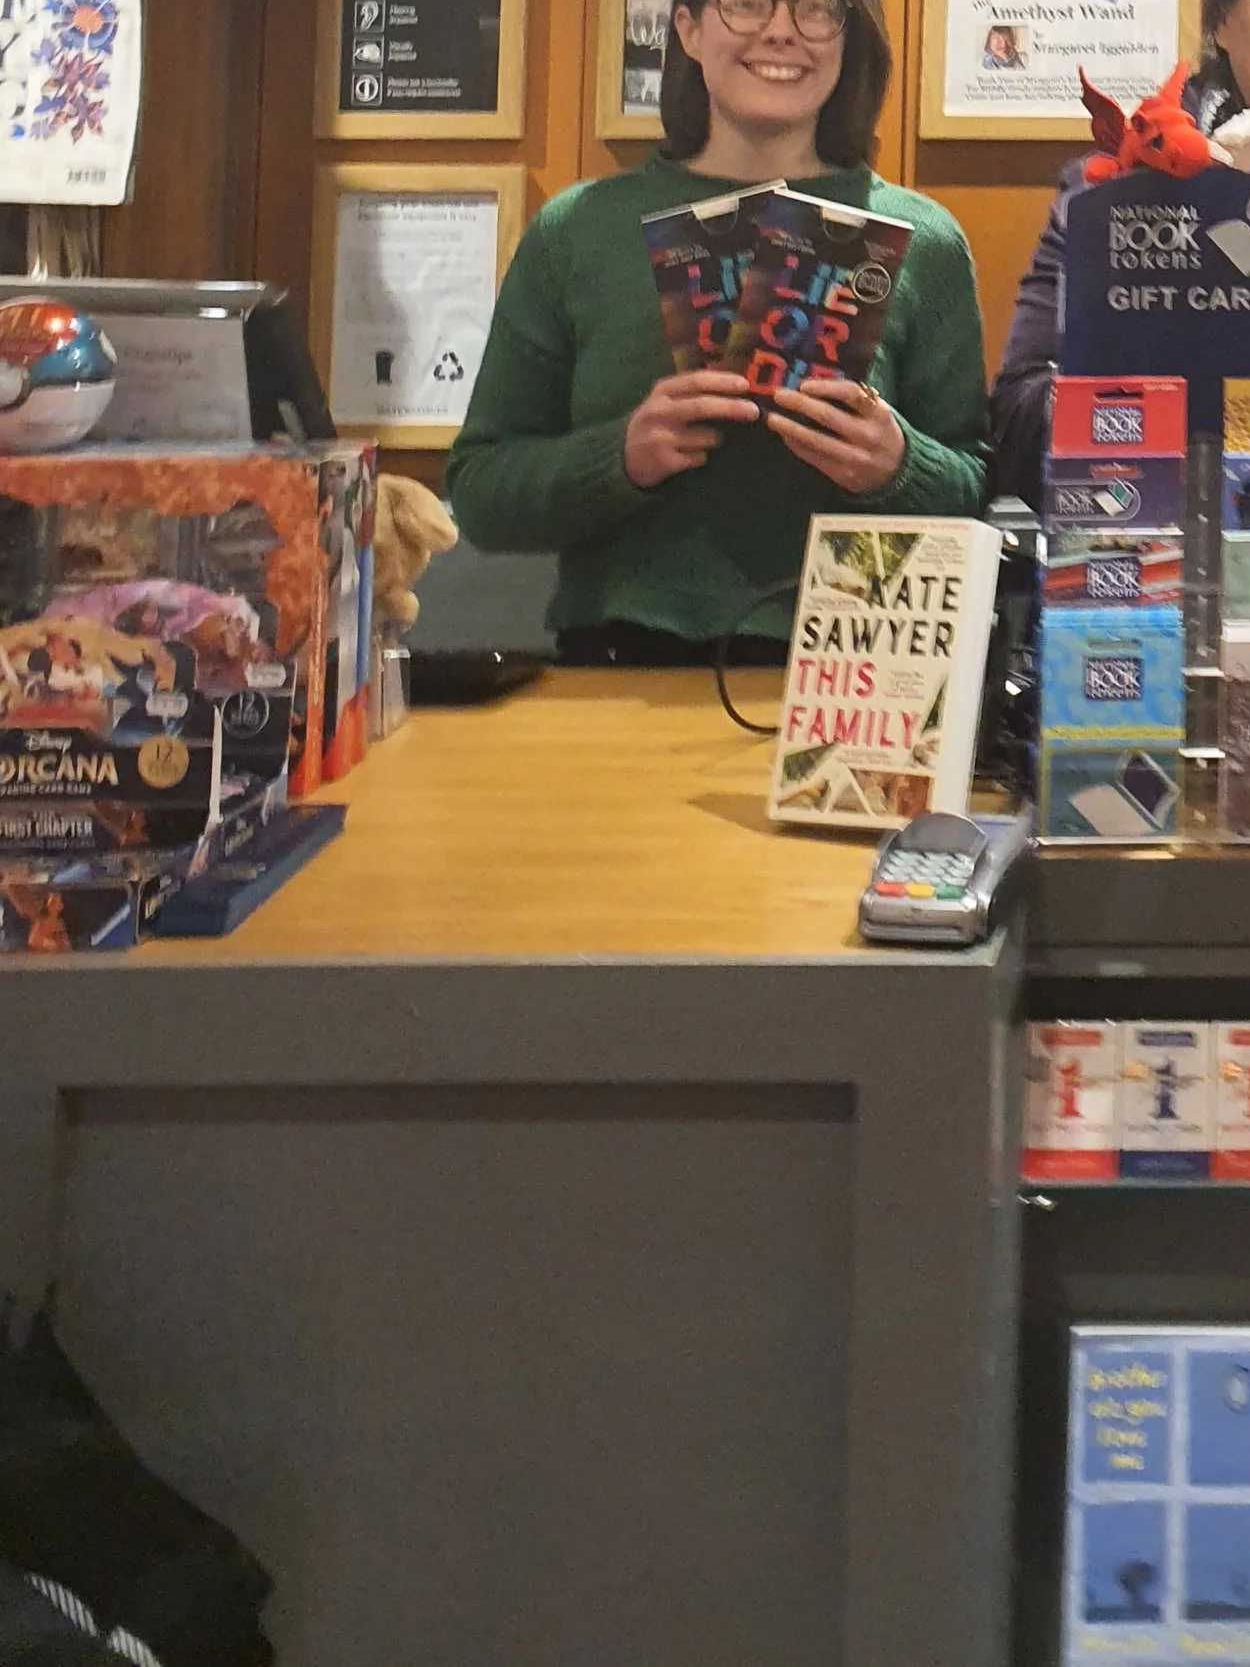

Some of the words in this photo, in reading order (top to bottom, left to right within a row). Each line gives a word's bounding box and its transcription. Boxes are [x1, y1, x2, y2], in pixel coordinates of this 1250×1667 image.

[987, 2, 1074, 22] Amethyst
[1080, 3, 1136, 21] Wand
[1109, 203, 1202, 222] NATIONAL
[1108, 220, 1202, 252] BOOK
[1109, 249, 1203, 270] tokens
[773, 254, 860, 316] LIE
[1107, 285, 1179, 312] GIFT
[760, 305, 850, 363] OR
[1093, 415, 1143, 433] BOOK
[800, 615, 955, 658] SAWYER
[795, 658, 877, 699] THIS
[785, 704, 924, 751] FAMILY
[155, 738, 174, 764] 12
